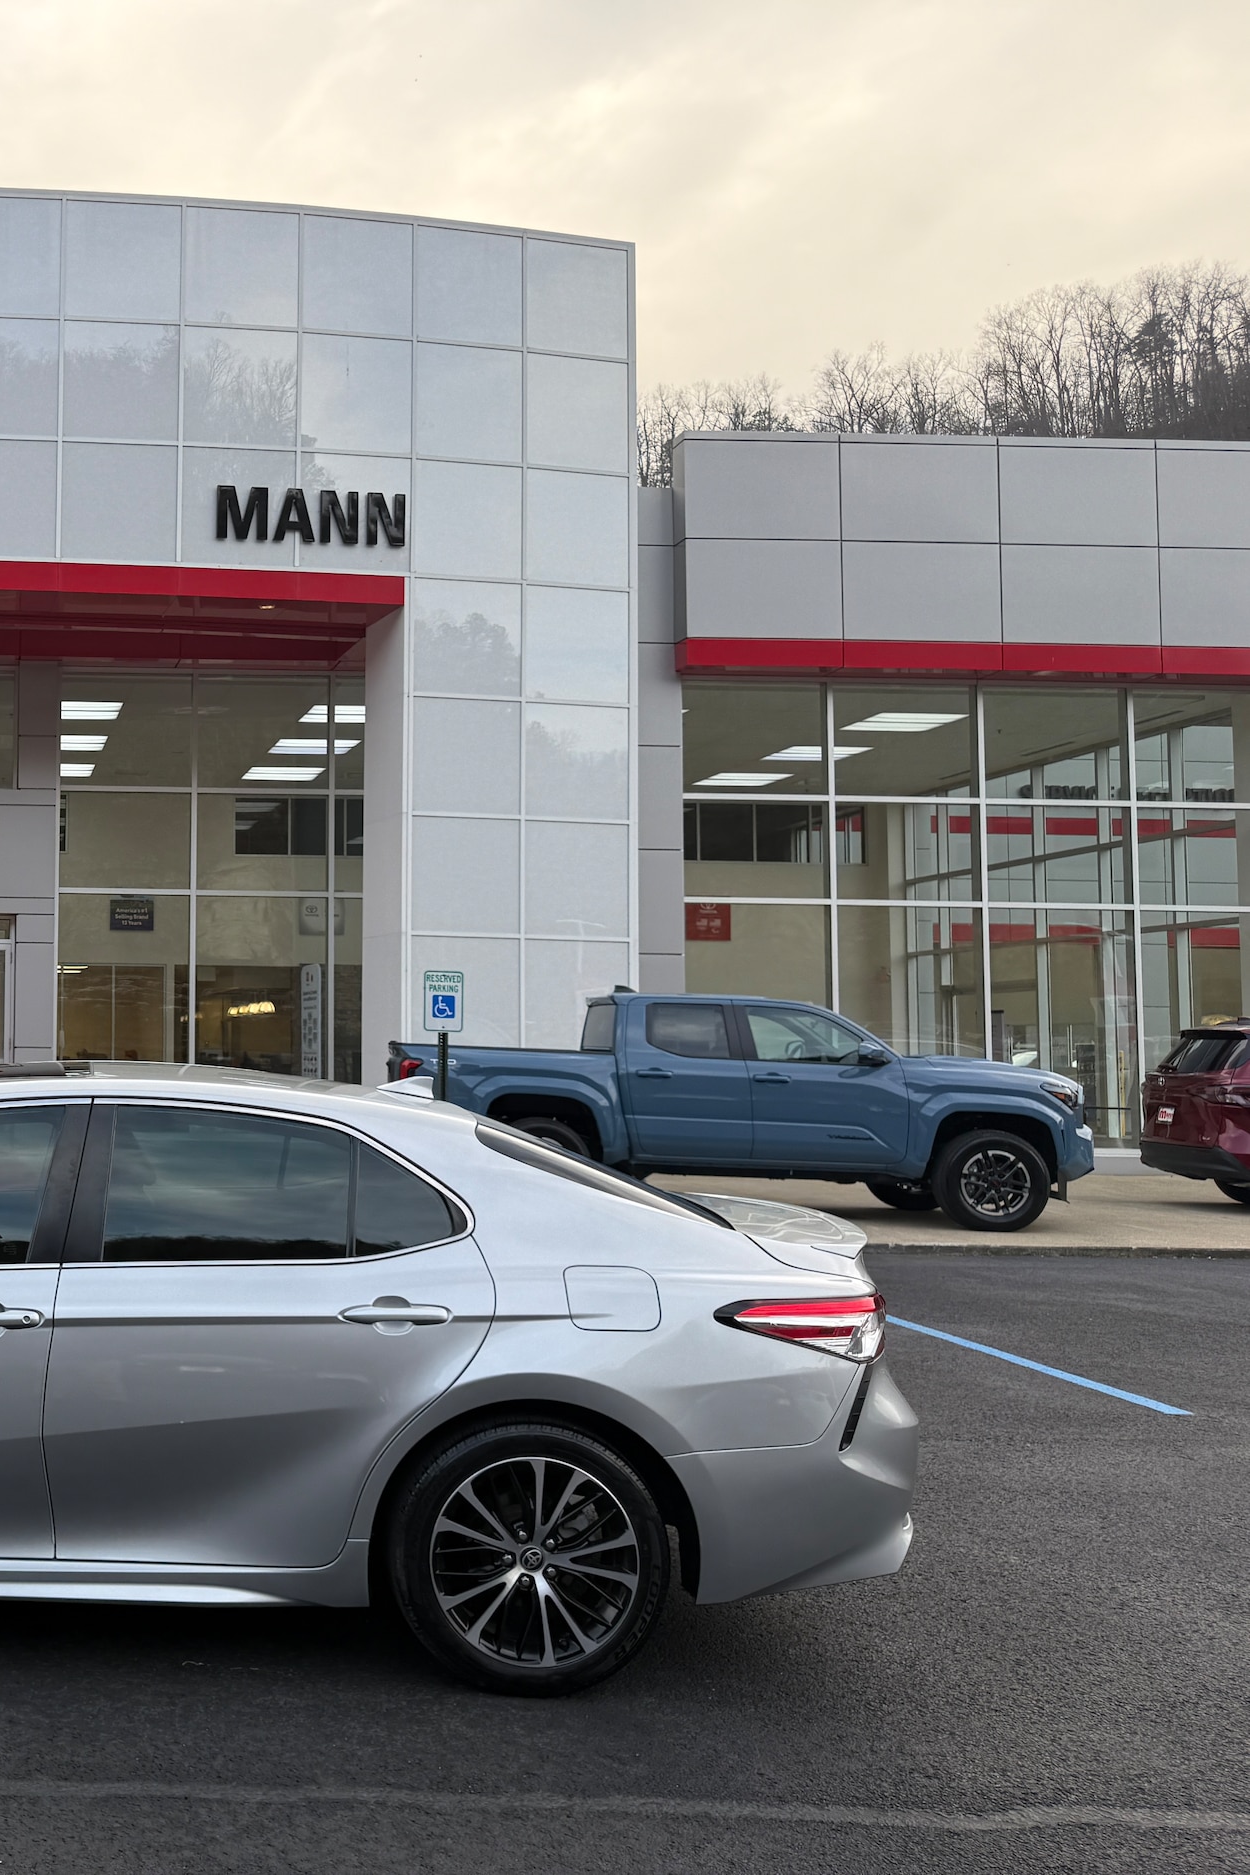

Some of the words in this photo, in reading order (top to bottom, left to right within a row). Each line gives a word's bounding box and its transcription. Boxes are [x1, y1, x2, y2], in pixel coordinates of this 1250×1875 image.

[216, 485, 406, 546] MANN
[426, 974, 462, 983] RESERVED
[428, 984, 459, 993] PARKING
[613, 1563, 661, 1662] COOPER
